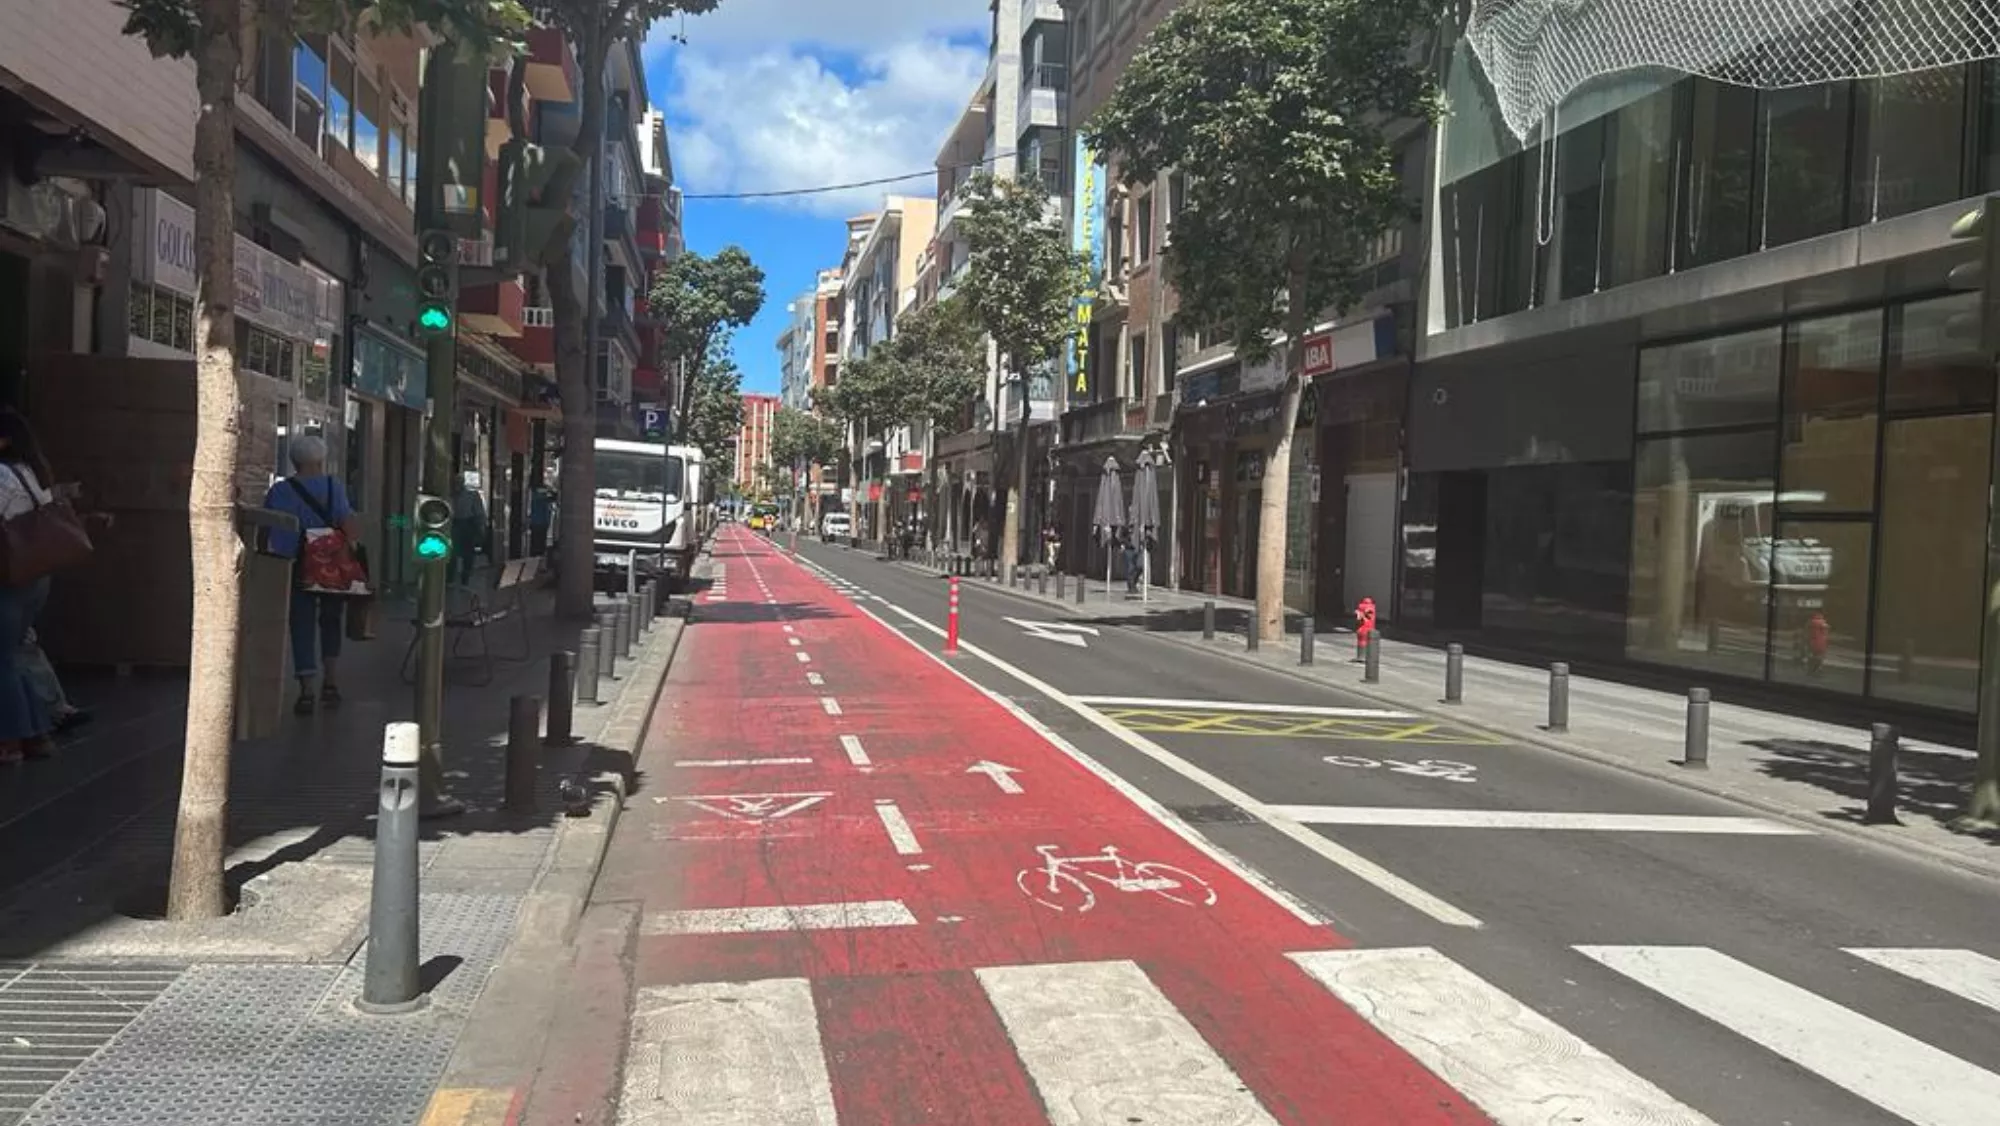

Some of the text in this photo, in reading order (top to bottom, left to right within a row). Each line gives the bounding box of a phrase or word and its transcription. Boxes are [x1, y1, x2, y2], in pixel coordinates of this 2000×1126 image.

[157, 218, 196, 275] GOLO
[645, 410, 658, 429] P
[597, 517, 639, 528] IVECO
